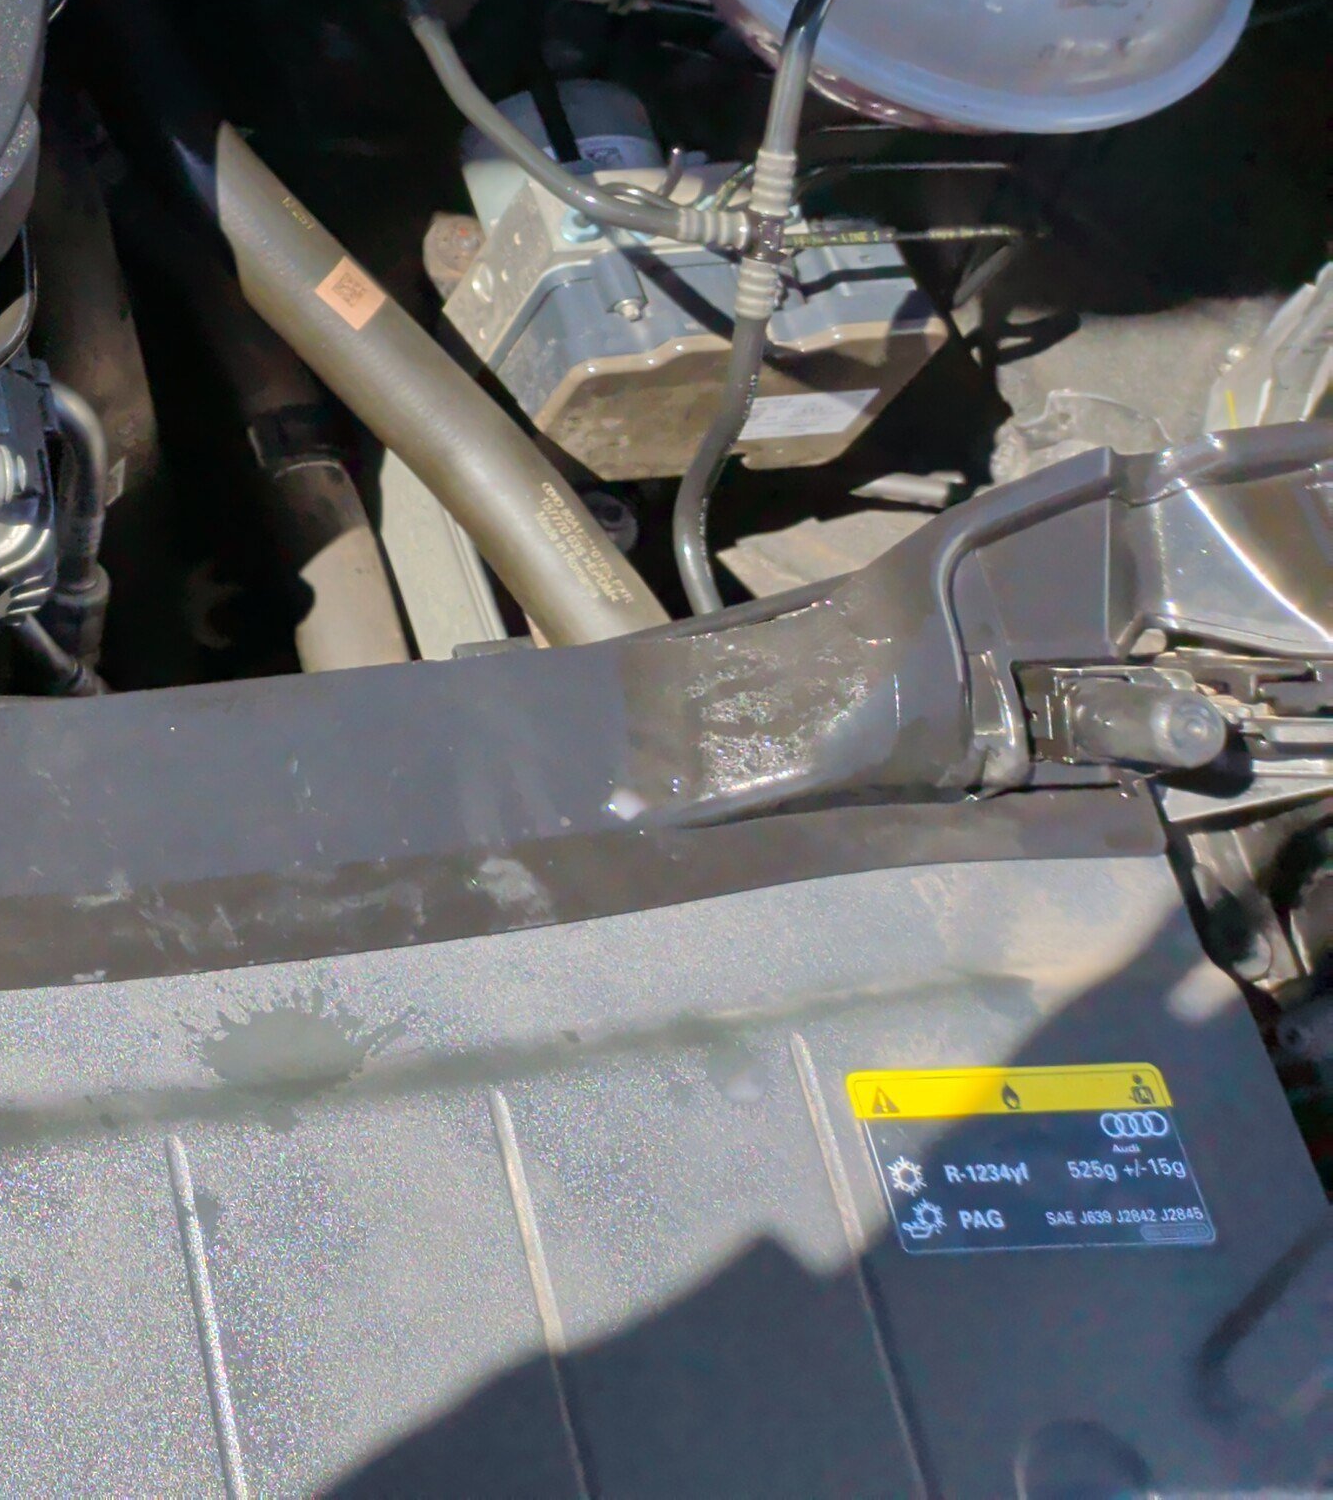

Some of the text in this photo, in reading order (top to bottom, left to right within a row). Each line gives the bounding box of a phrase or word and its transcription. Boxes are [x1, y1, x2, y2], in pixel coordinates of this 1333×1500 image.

[1112, 1144, 1142, 1154] Audi
[943, 1162, 1030, 1186] R-1234yf
[1067, 1159, 1117, 1182] 525g
[958, 1206, 1204, 1229] PAG SAE J639 J2842 J2845
